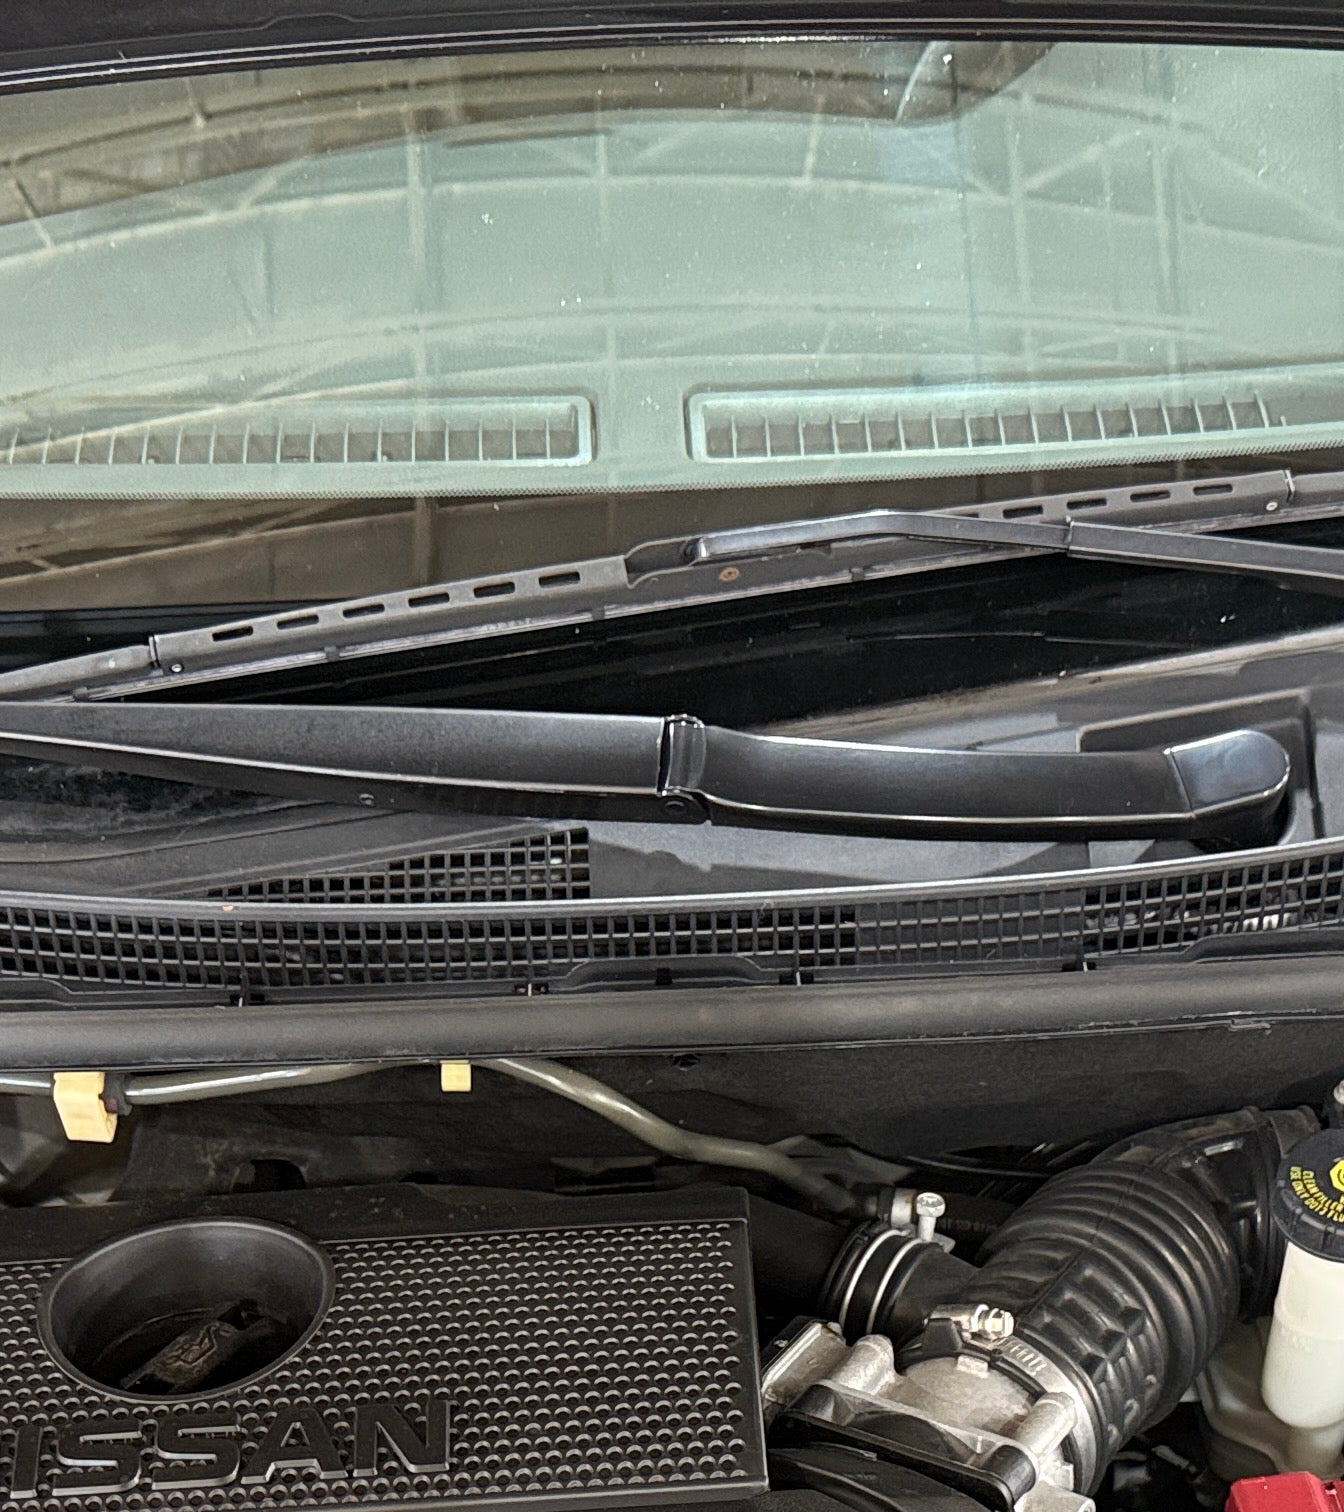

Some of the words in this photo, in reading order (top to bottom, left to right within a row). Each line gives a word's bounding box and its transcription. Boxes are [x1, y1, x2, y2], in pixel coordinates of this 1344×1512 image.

[1290, 1166, 1302, 1180] USE
[1292, 1181, 1310, 1199] ONLY
[1302, 1170, 1320, 1193] CLEAN
[1313, 1191, 1344, 1212] FILLER
